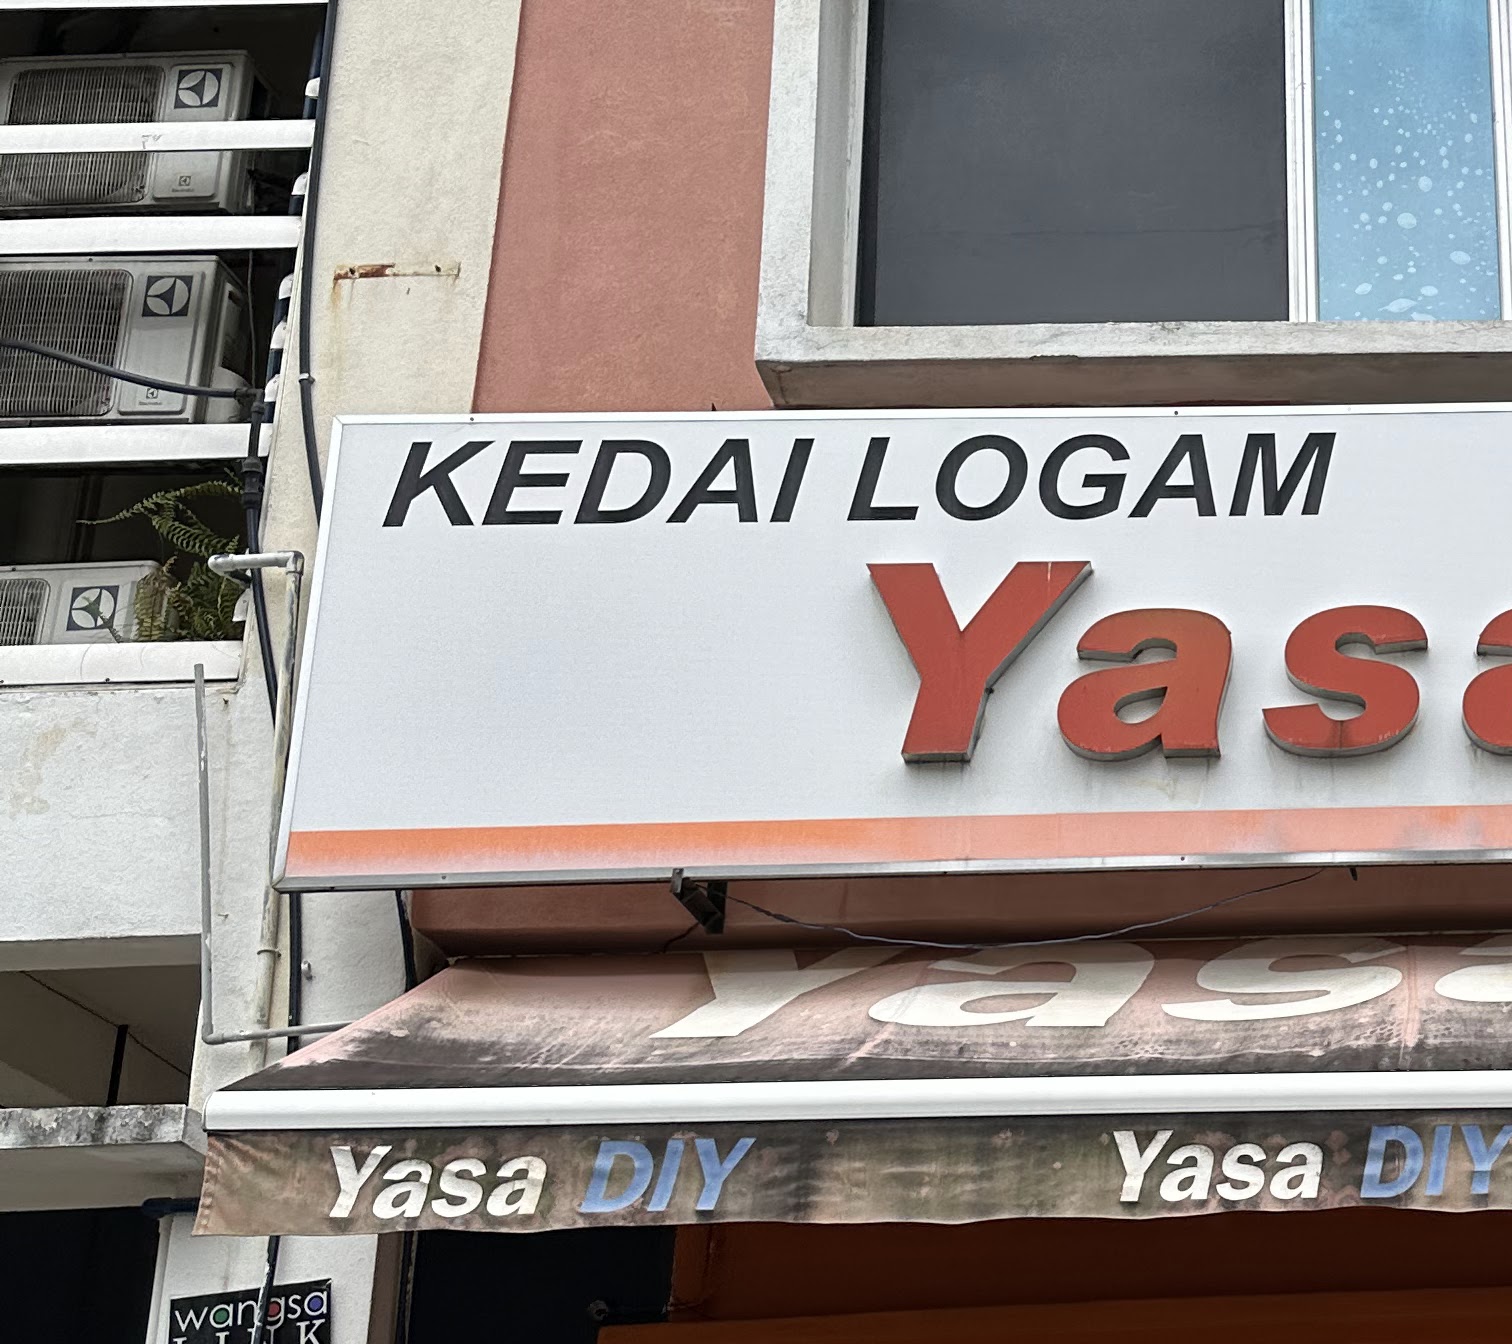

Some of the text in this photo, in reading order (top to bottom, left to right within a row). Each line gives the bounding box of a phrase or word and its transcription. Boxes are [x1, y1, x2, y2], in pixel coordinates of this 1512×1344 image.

[382, 432, 1337, 527] KEDAI LOGAM
[326, 1136, 758, 1224] Yasa DIY
[1111, 1128, 1325, 1204] Yasa
[174, 1290, 329, 1333] wangsa
